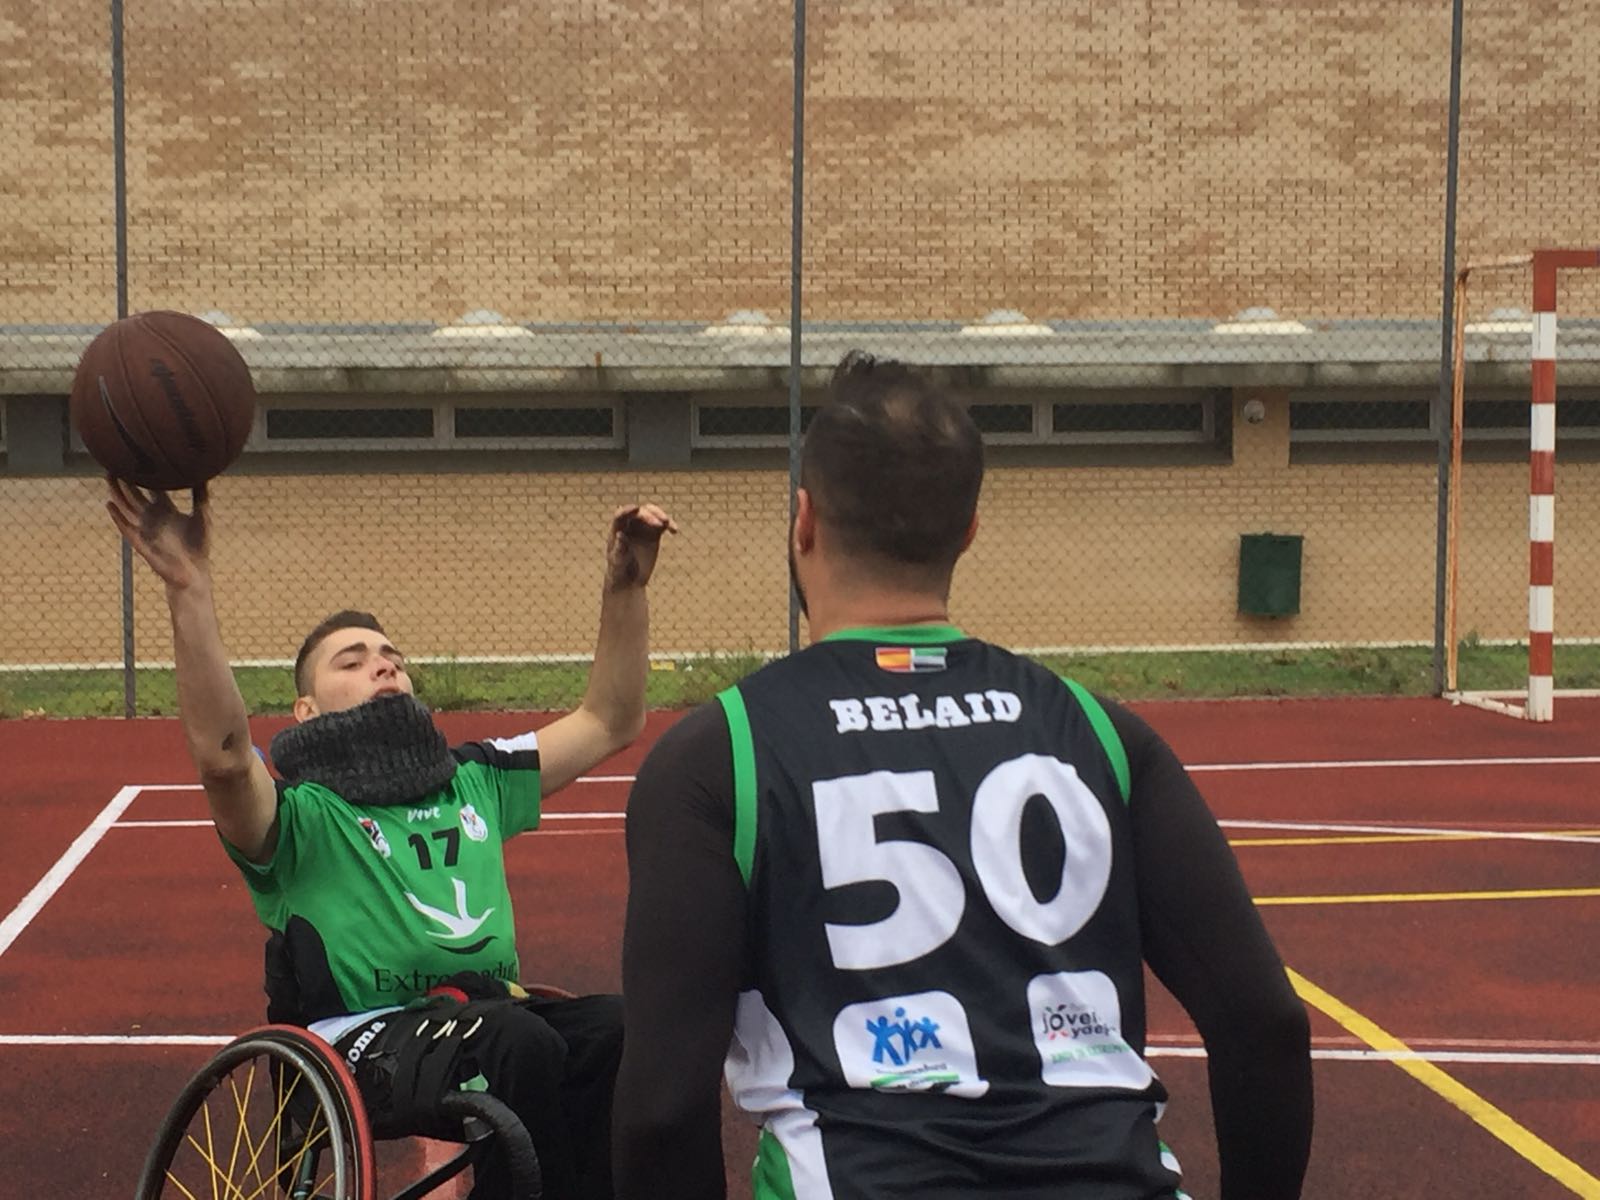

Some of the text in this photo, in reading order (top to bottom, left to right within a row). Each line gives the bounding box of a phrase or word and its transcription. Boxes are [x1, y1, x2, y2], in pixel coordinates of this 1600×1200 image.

[828, 689, 1022, 734] BELAID
[407, 826, 460, 870] 17
[811, 753, 1113, 970] 50
